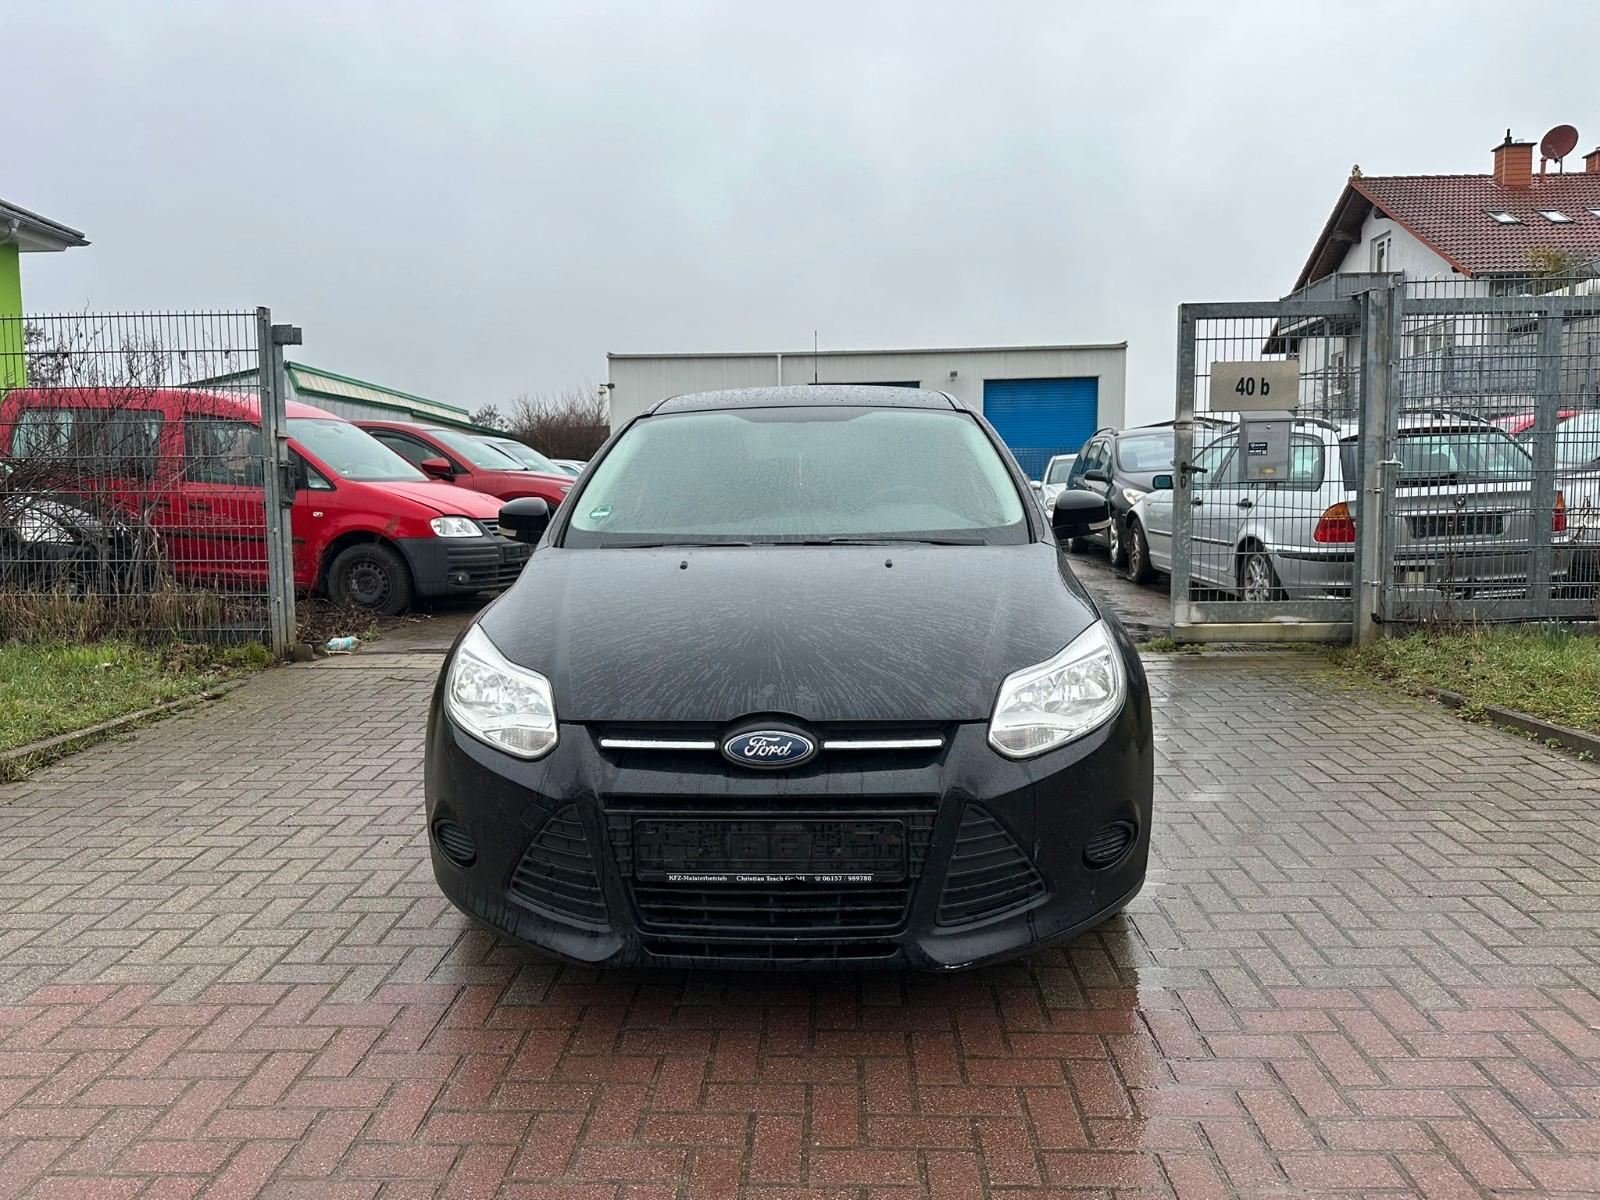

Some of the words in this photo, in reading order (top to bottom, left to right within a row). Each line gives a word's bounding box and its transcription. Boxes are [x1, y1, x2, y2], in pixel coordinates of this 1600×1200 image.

[1235, 377, 1255, 396] 40
[1260, 377, 1270, 396] b
[744, 735, 793, 757] Ford
